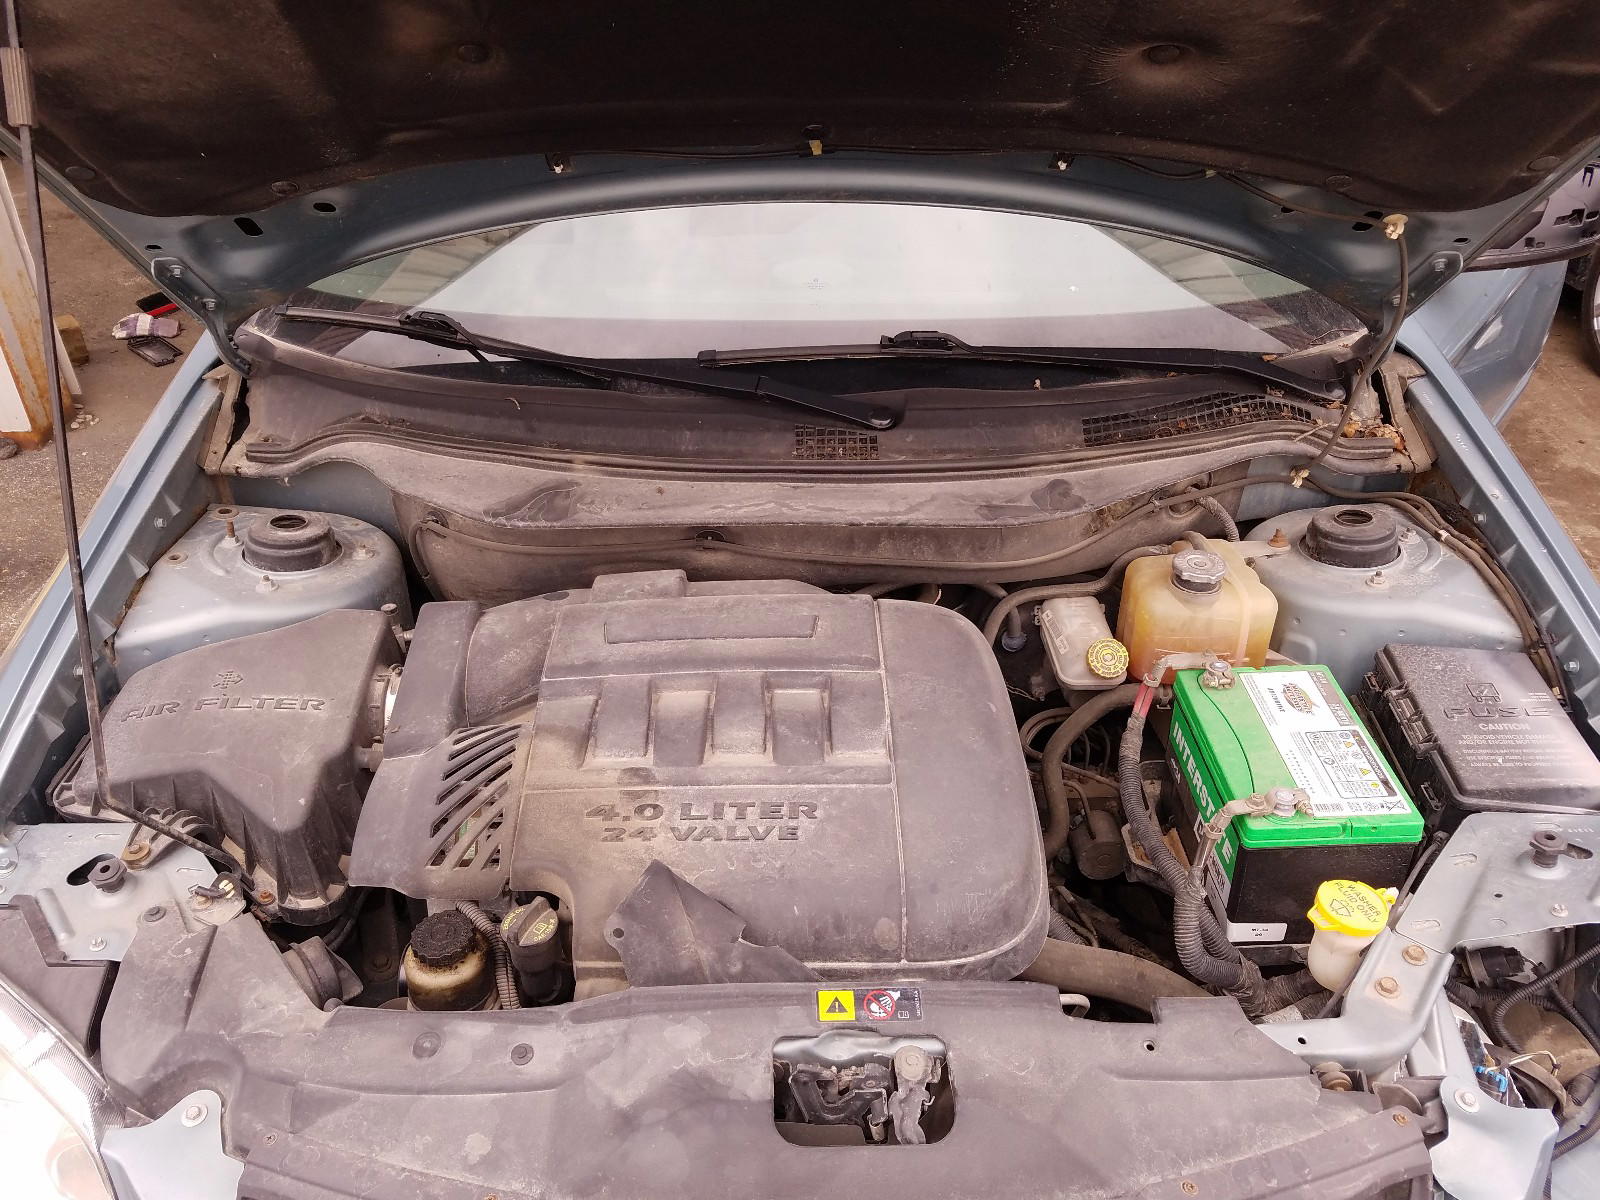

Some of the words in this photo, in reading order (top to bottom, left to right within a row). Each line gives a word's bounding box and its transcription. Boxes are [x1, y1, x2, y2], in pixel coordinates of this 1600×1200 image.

[120, 700, 181, 723] AIR
[195, 696, 329, 711] FILTER
[1443, 705, 1553, 720] FUSE
[1479, 723, 1531, 731] CAUTION
[1172, 720, 1233, 865] INTERSTE
[584, 803, 664, 821] 4.0
[679, 801, 818, 820] LITER
[600, 826, 657, 842] 24
[669, 825, 800, 842] VALVE
[1335, 881, 1357, 903] FLUID
[1356, 904, 1379, 923] ONLY
[1347, 885, 1381, 917] WASHER
